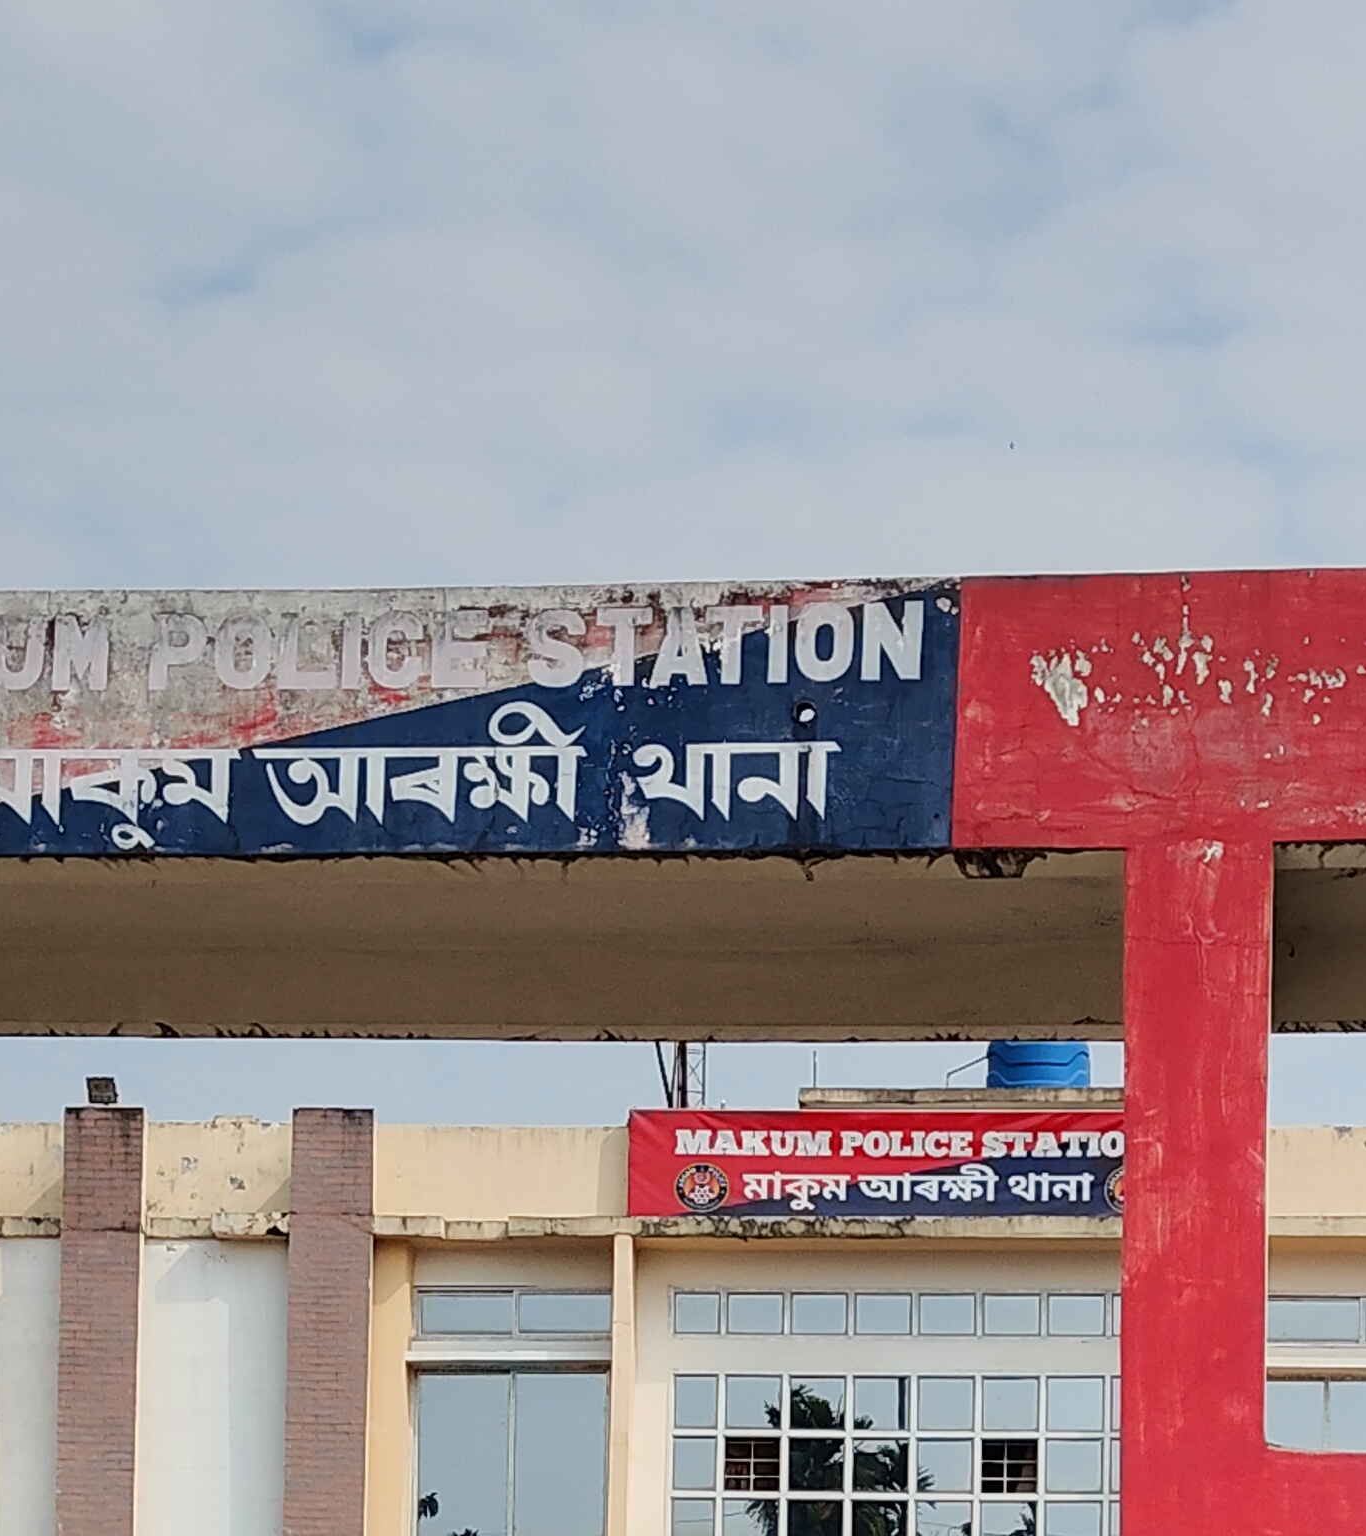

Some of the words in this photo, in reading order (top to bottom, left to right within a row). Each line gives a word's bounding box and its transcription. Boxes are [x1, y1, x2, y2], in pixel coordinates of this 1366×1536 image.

[147, 607, 489, 692] POLICE
[526, 599, 925, 689] STATION
[253, 701, 588, 826] আৰক্ষী
[634, 741, 842, 823] থানা
[674, 1129, 833, 1157] MAKUM
[840, 1130, 973, 1157] POLICE
[981, 1130, 1125, 1158] STATIO
[742, 1171, 851, 1211] মাকুম
[857, 1164, 999, 1202] আৰক্ষী
[1008, 1172, 1095, 1202] থানা
